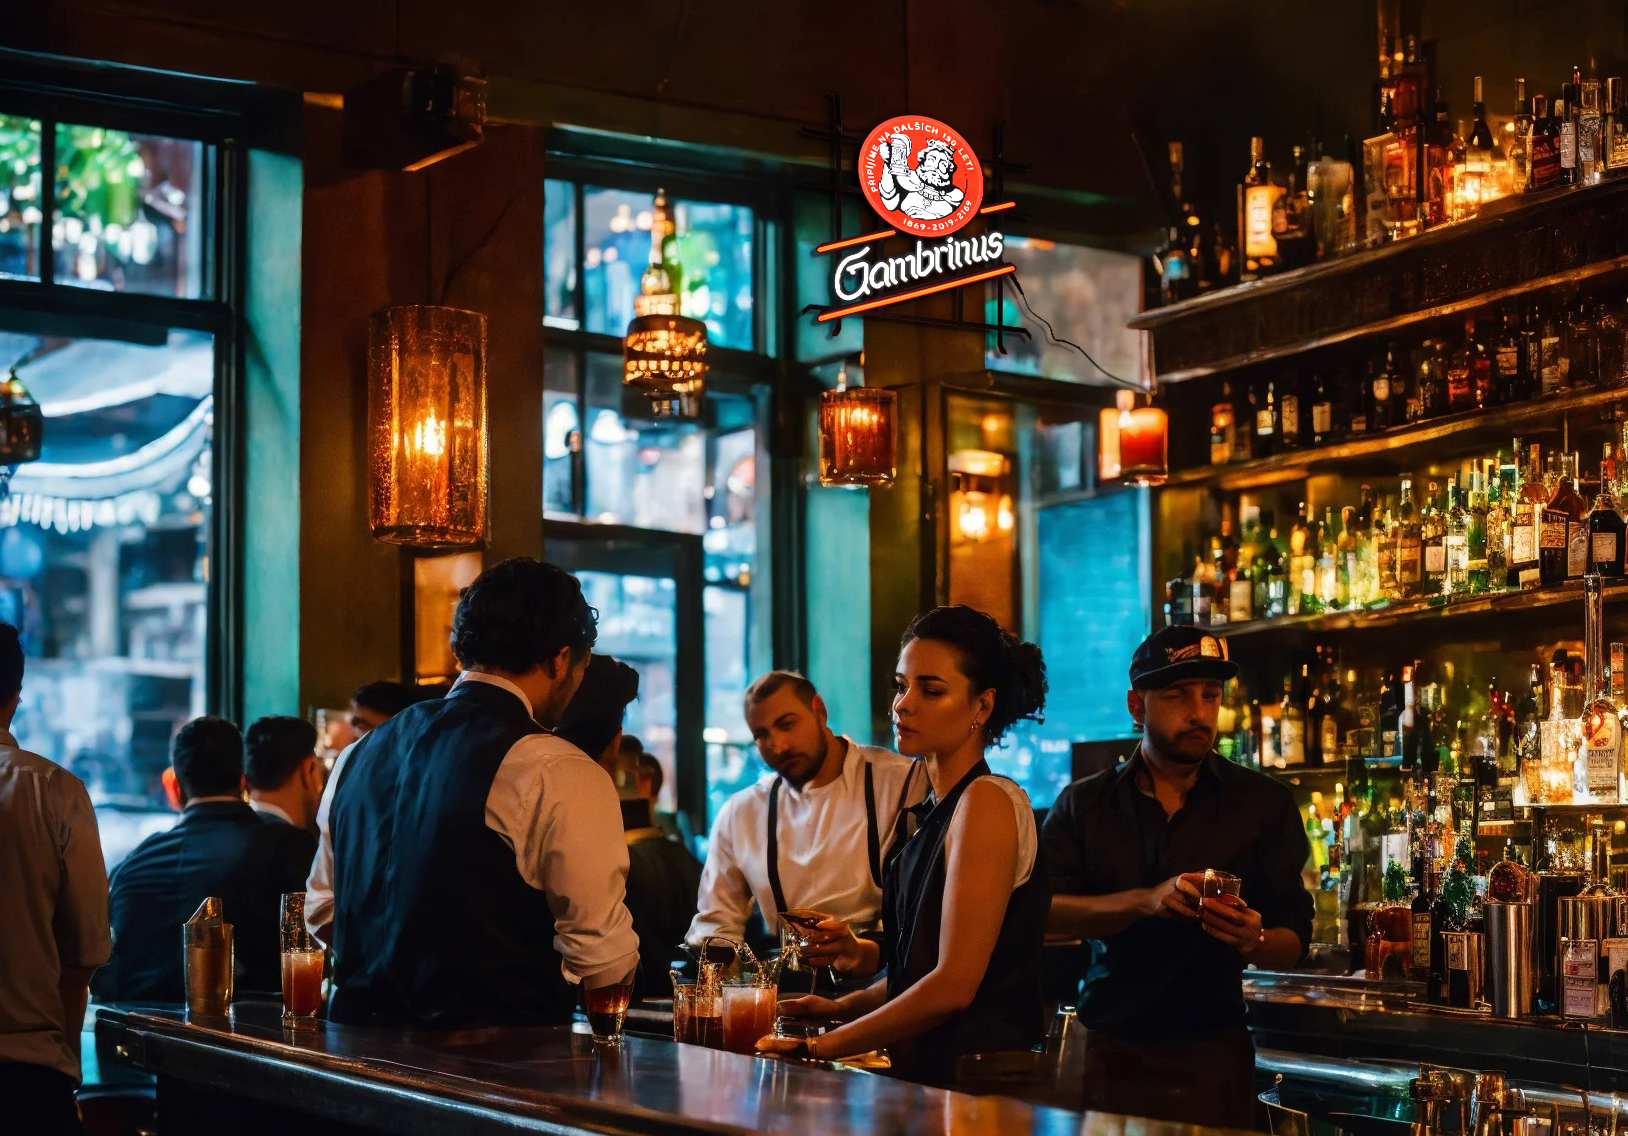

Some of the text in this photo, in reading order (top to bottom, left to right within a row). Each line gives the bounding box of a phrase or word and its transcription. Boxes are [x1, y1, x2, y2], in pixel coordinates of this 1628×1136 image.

[877, 131, 891, 144] NA
[893, 121, 939, 135] DALŠÍCH
[942, 132, 957, 147] 150
[902, 200, 972, 231] 1869-2019-2169
[834, 231, 1004, 301] Gambrinus
